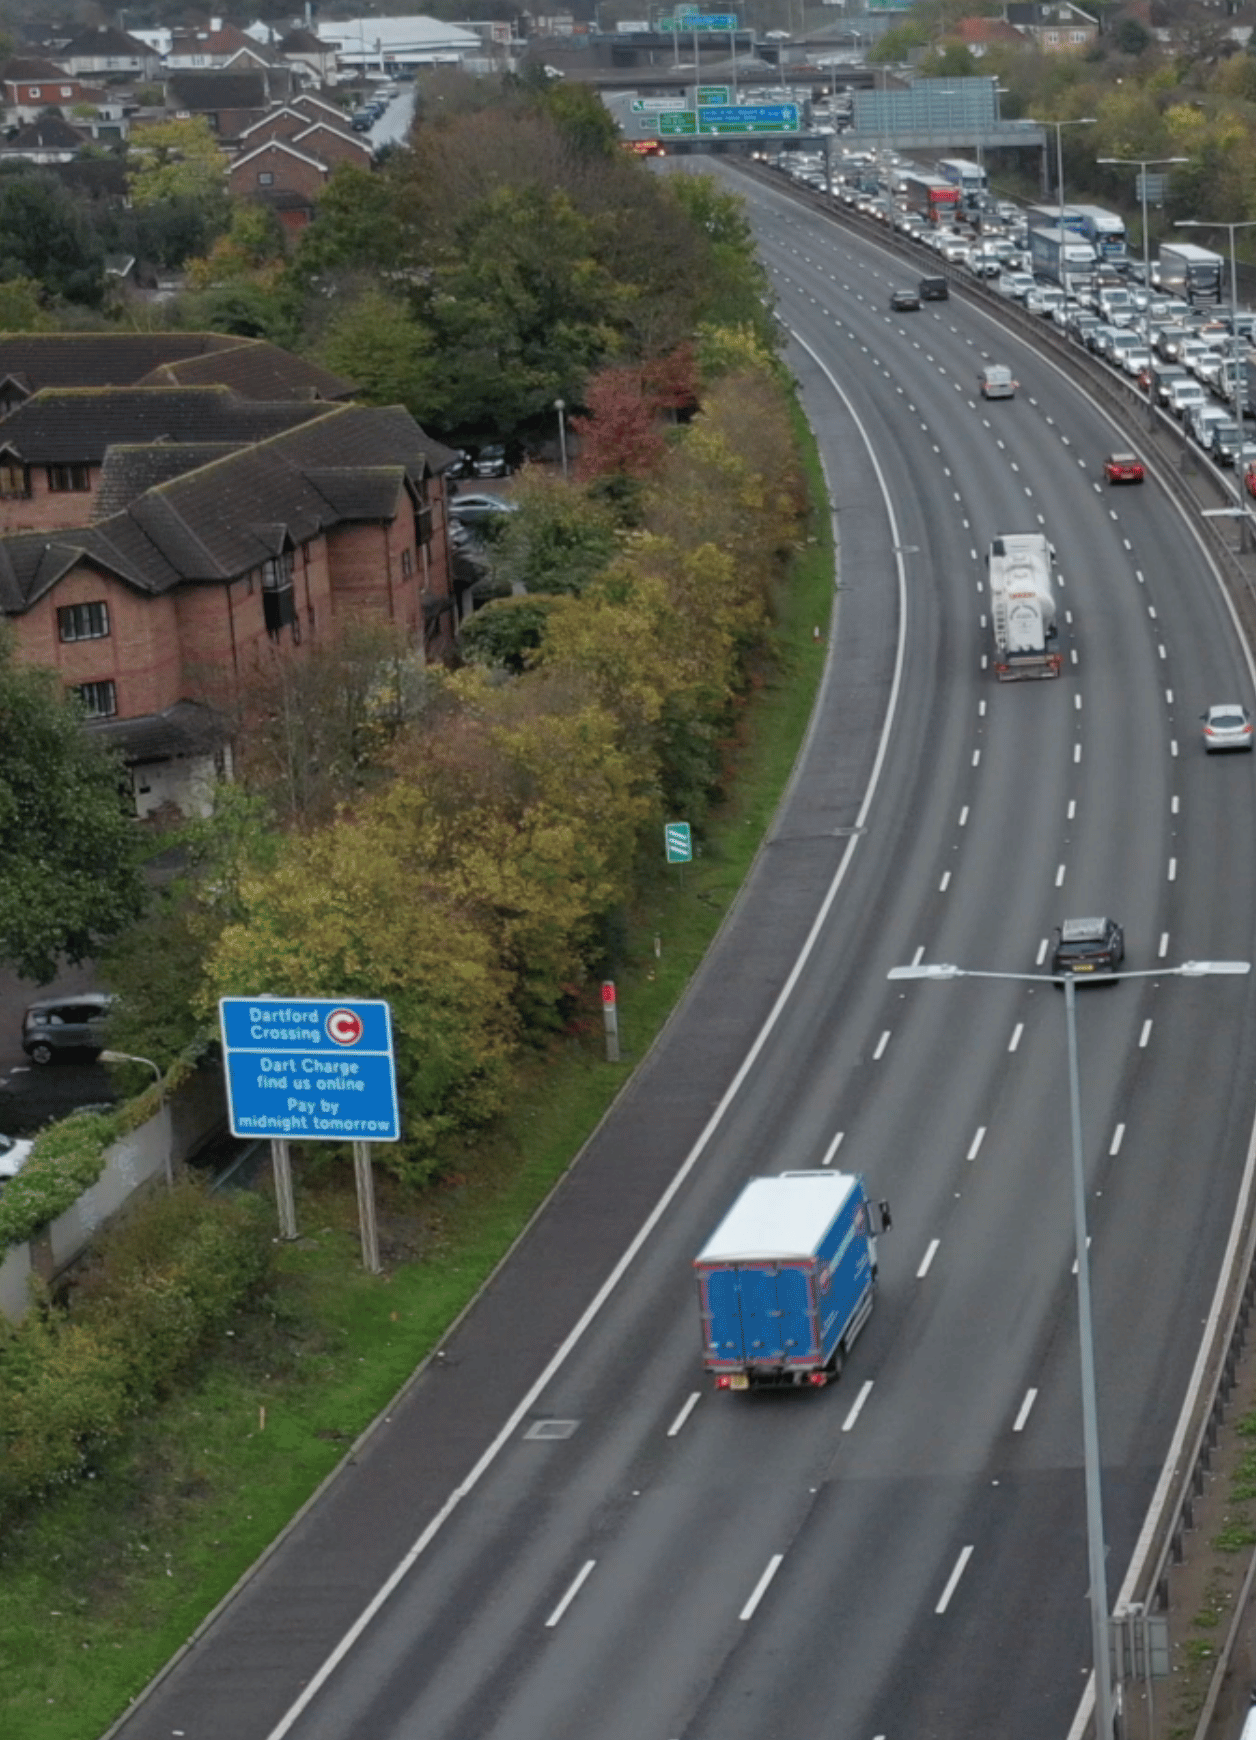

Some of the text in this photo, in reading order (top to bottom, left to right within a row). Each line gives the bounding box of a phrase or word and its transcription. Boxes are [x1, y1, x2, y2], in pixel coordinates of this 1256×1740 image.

[249, 1007, 319, 1023] Dartford
[250, 1025, 321, 1043] Crossing
[260, 1057, 359, 1076] Dart Charge
[257, 1074, 365, 1091] find us online
[287, 1097, 340, 1116] Pay by
[239, 1115, 390, 1132] midnight tomorrow
